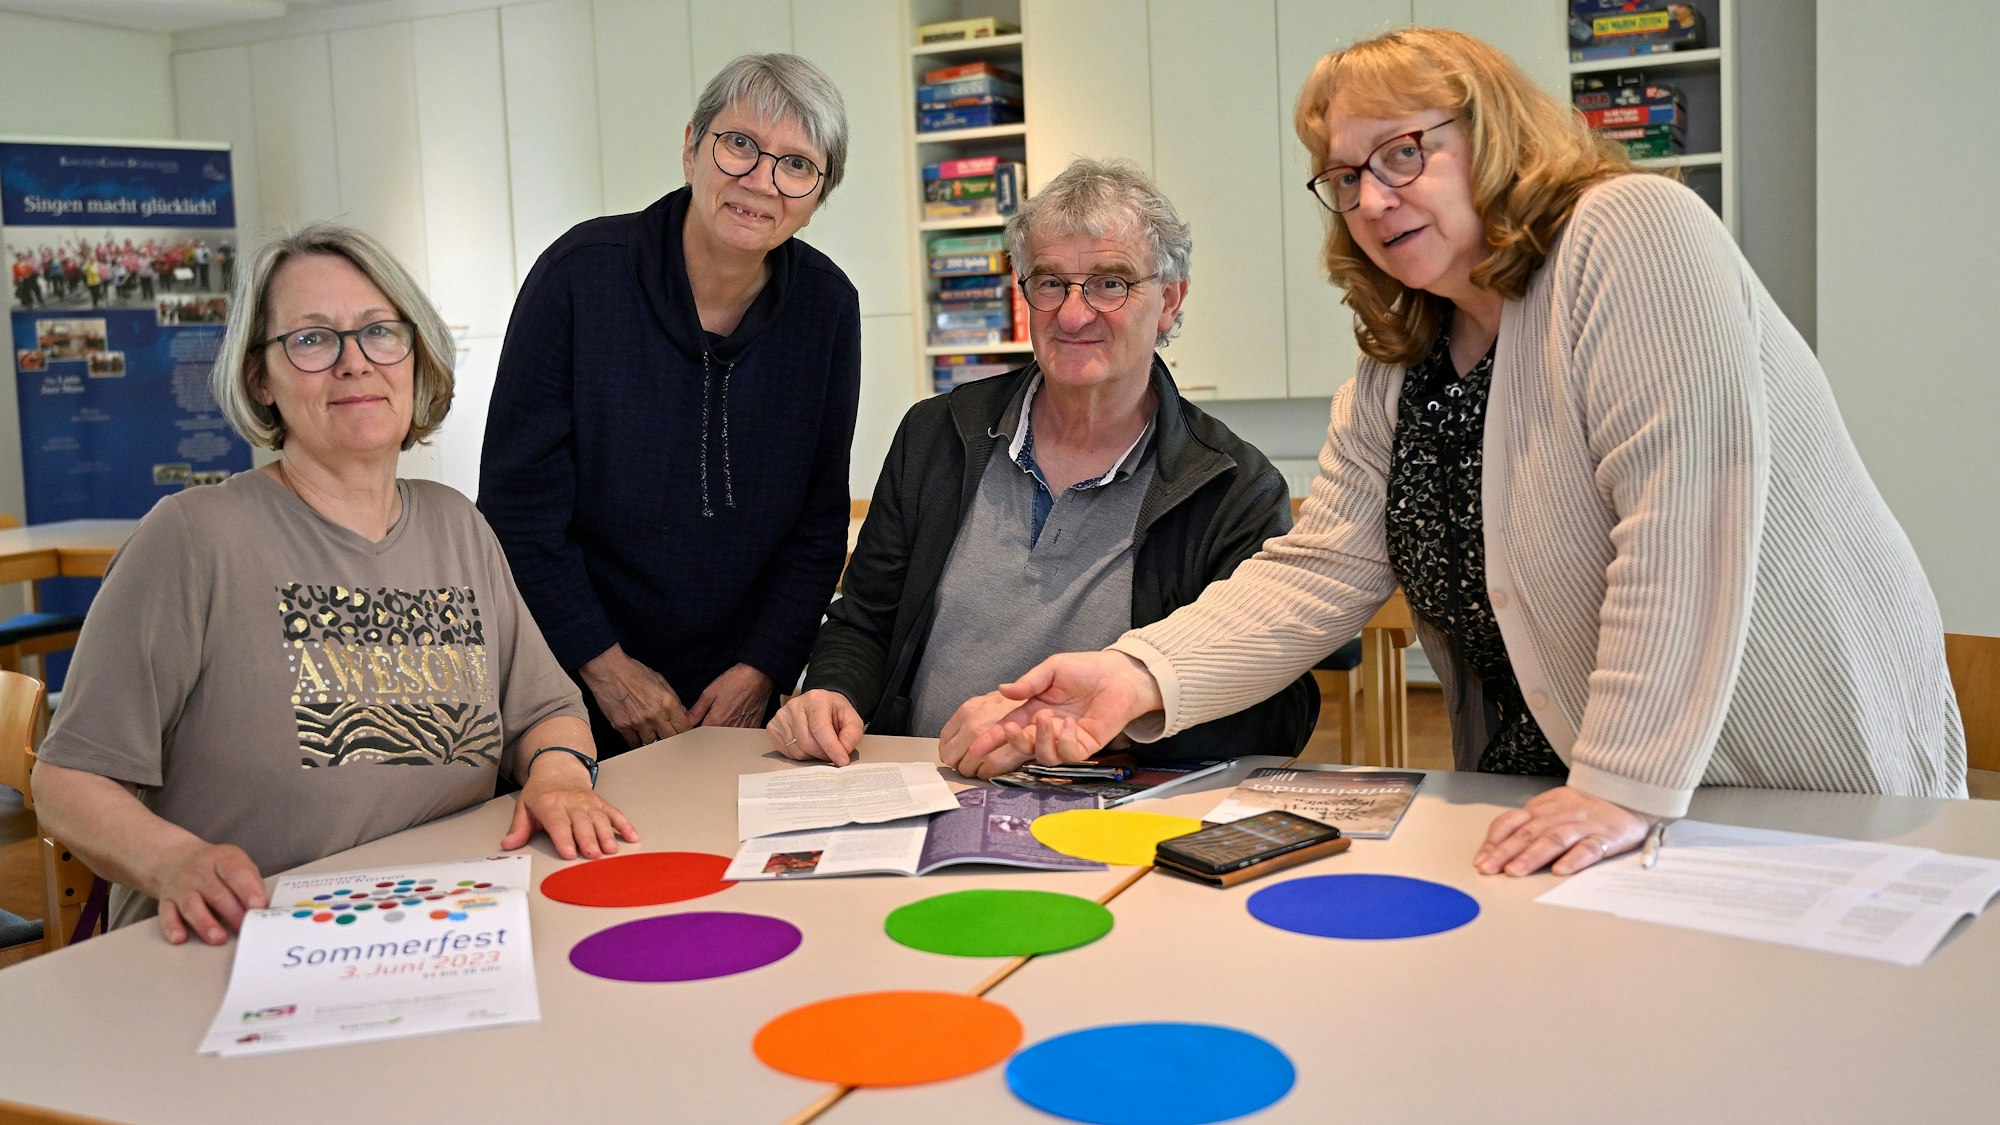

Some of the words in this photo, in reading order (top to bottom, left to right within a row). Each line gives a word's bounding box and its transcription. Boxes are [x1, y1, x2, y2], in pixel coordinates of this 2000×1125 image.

[23, 194, 84, 216] Singen
[87, 196, 137, 214] macht
[140, 197, 217, 217] glücklich!
[283, 928, 508, 969] Sommerfest
[339, 964, 360, 981] 3.
[365, 958, 425, 977] Juni
[432, 950, 502, 970] 2023
